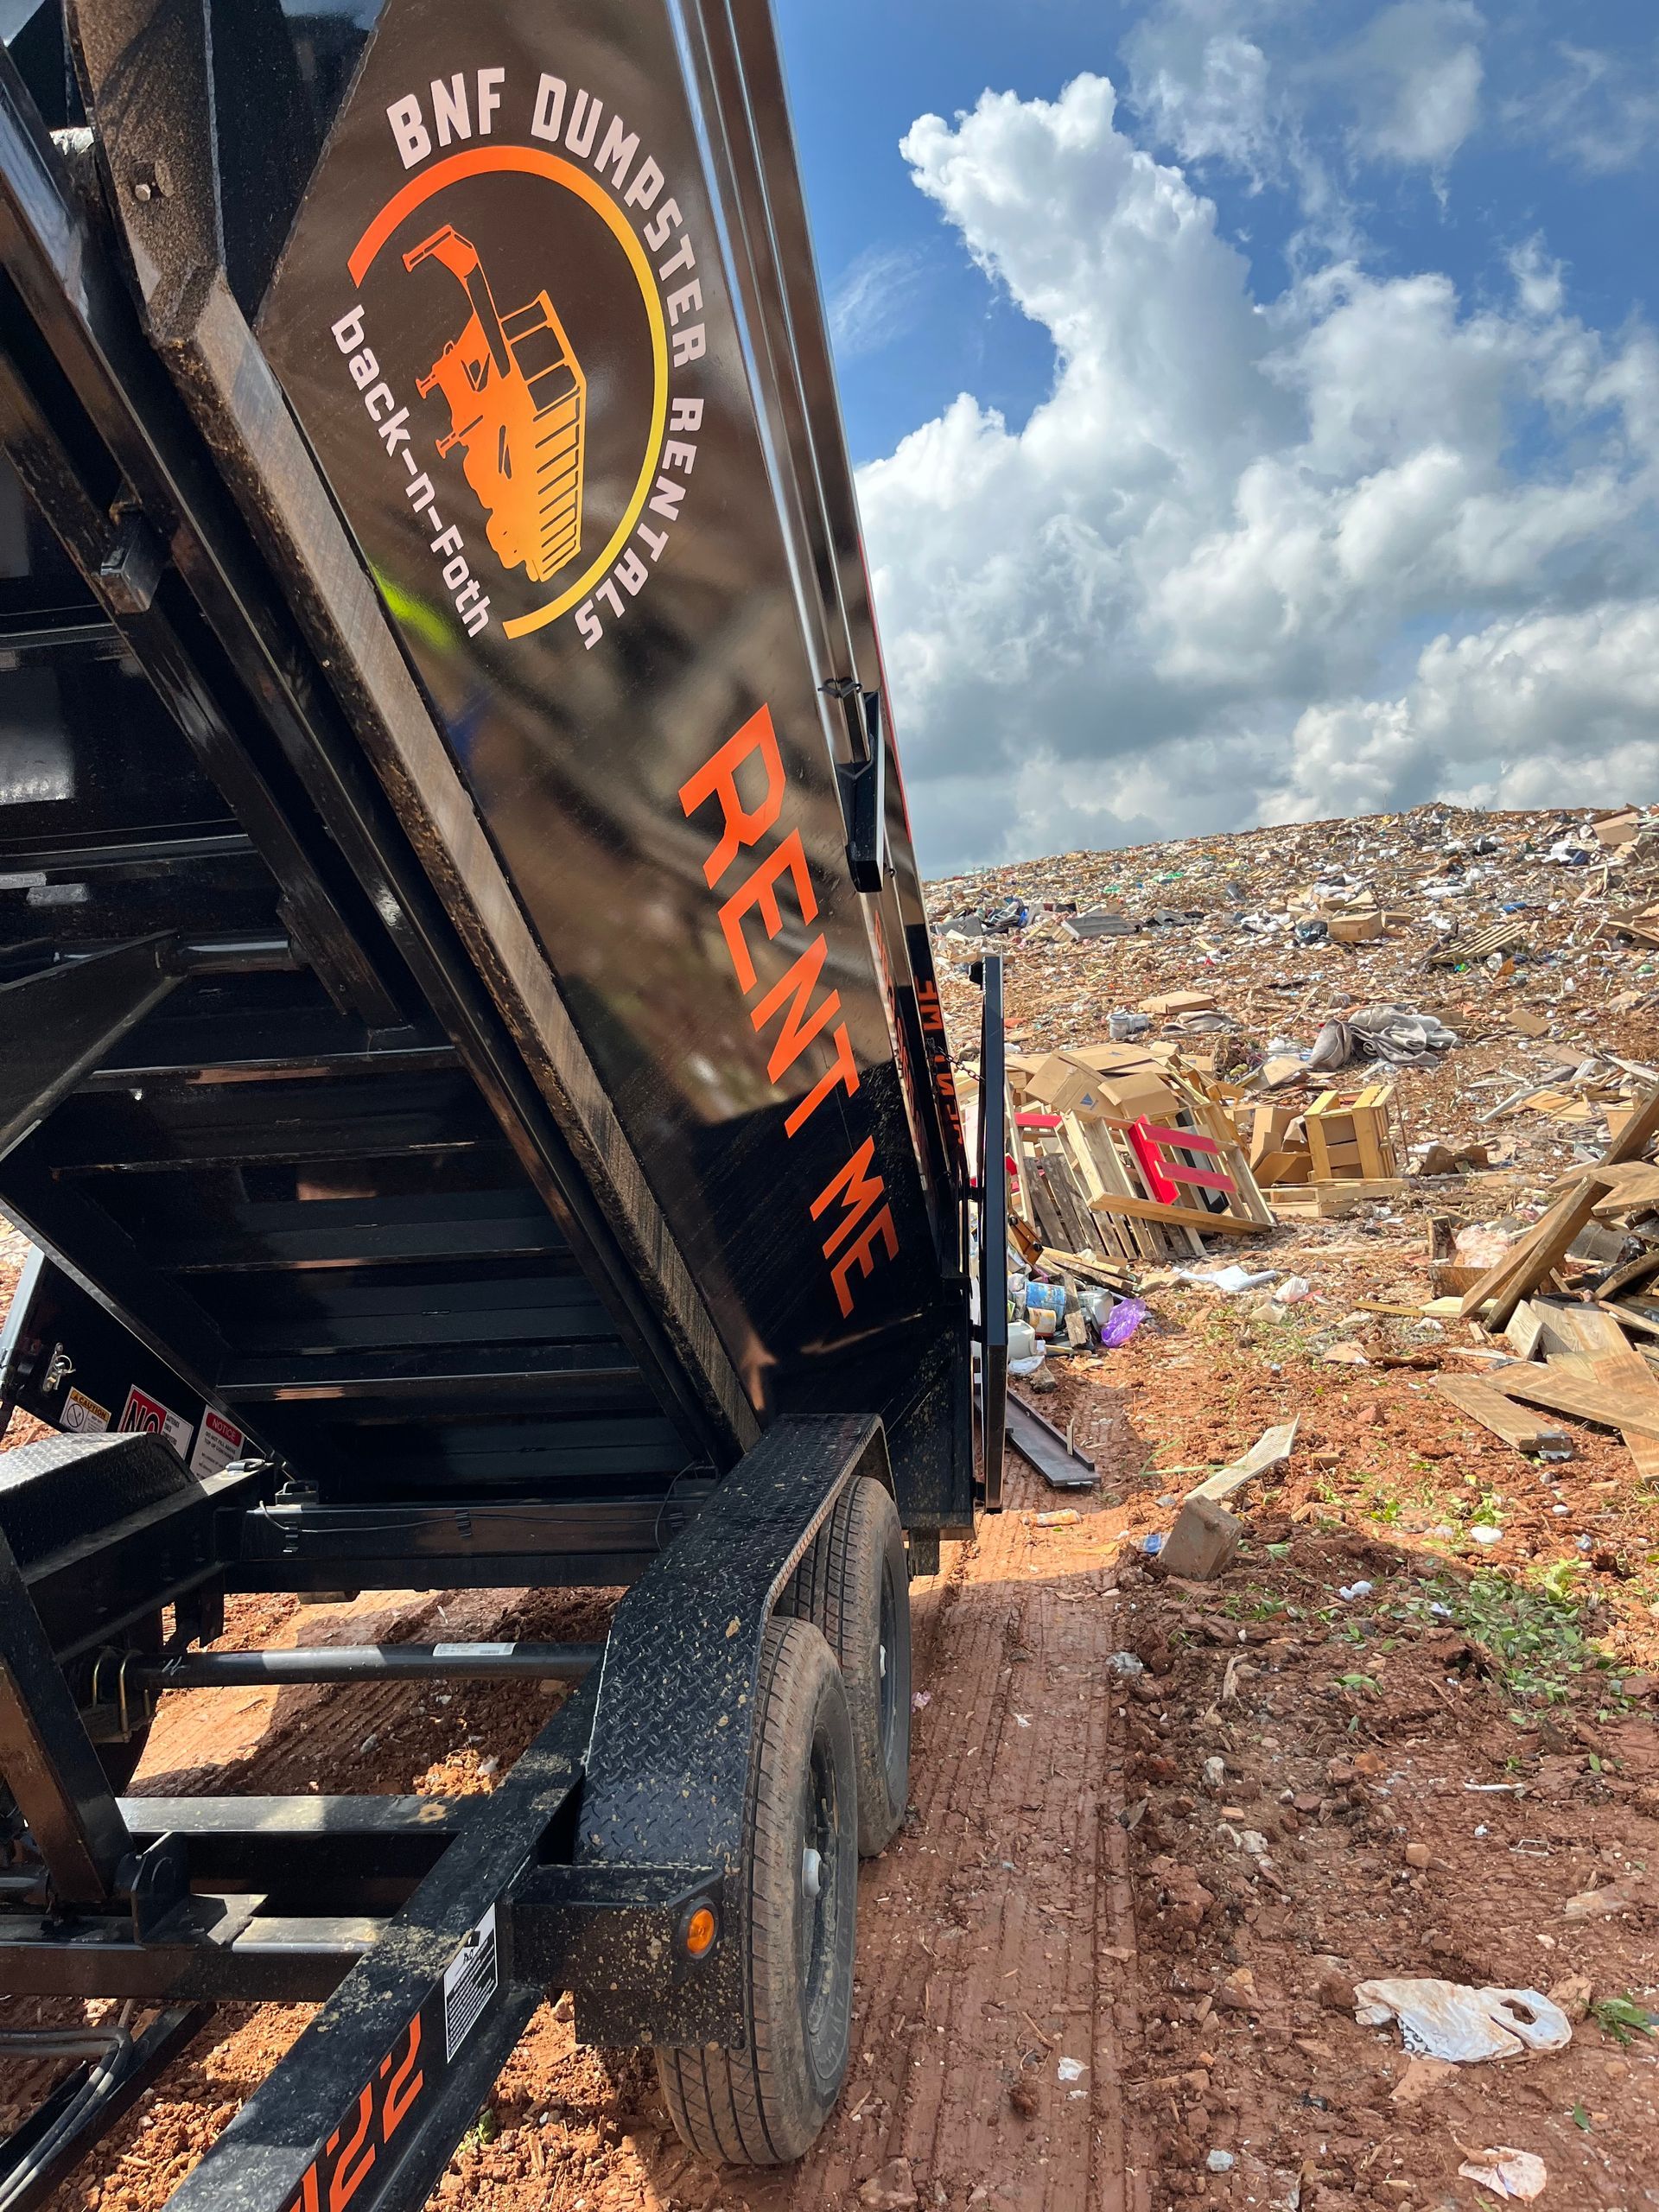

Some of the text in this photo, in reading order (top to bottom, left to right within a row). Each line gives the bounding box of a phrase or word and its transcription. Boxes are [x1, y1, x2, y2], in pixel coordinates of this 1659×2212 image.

[387, 67, 707, 651] BNF DUMPSTER RENTALS
[331, 305, 491, 639] back-n-Foth
[678, 702, 899, 1319] RENT ME
[79, 1396, 106, 1419] CAUTION
[123, 1398, 160, 1433] NO
[212, 1418, 236, 1440] NOTICE
